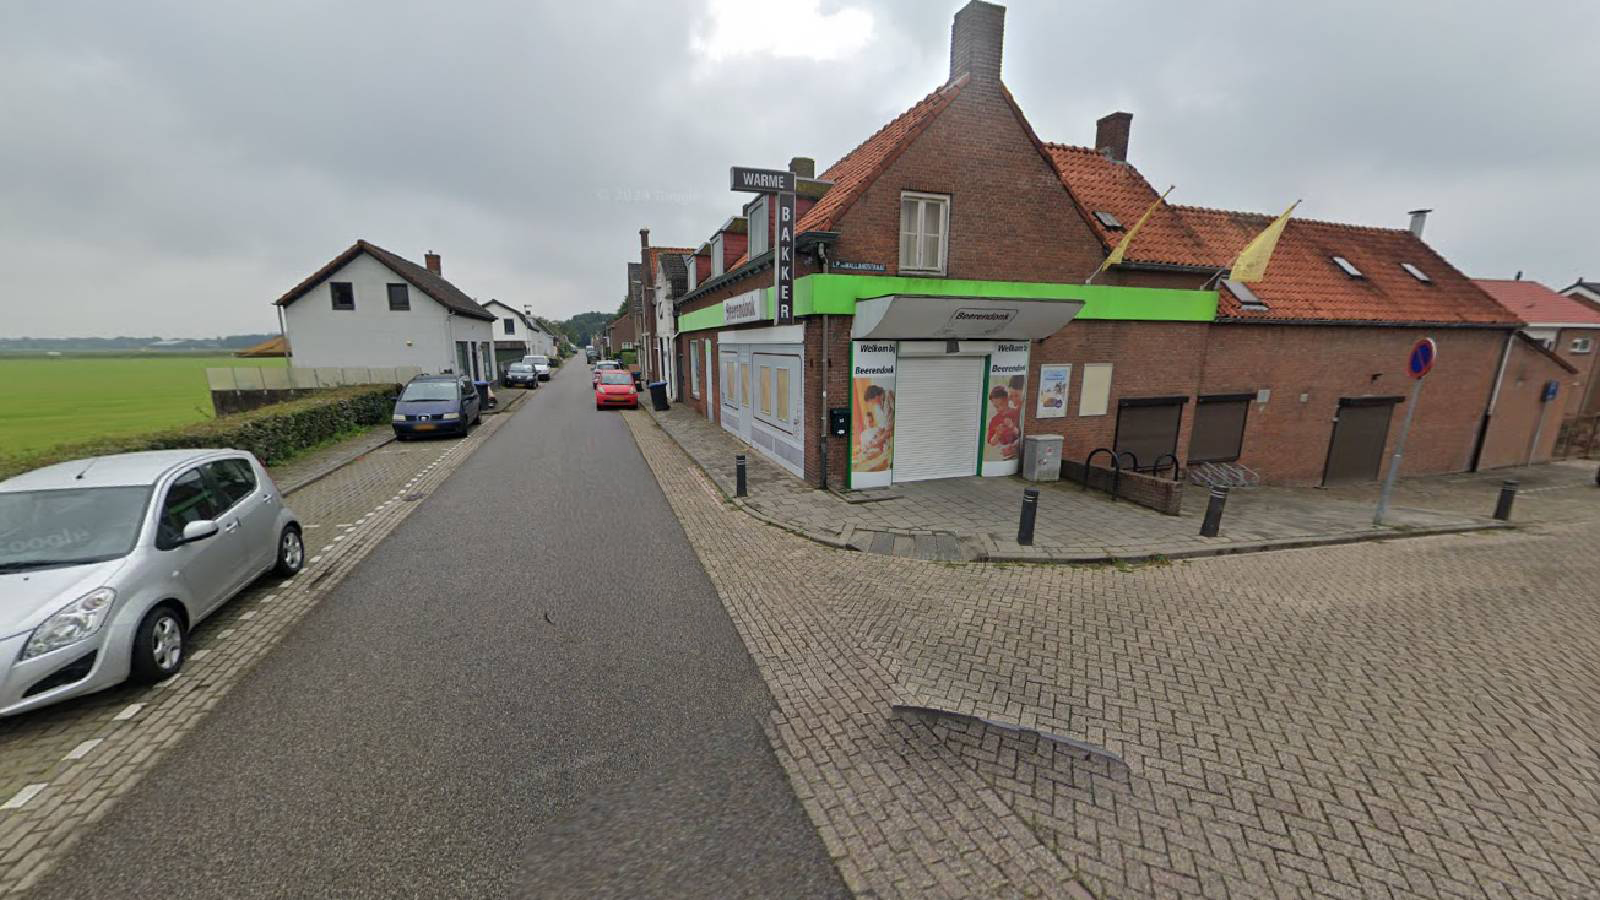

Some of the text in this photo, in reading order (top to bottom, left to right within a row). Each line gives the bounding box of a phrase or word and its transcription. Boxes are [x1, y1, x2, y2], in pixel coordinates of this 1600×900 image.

[743, 172, 784, 189] WARME
[780, 206, 791, 319] BAKKER
[955, 312, 1009, 321] Beerendonk
[860, 344, 888, 353] Welkom
[855, 365, 894, 375] Beerendonk
